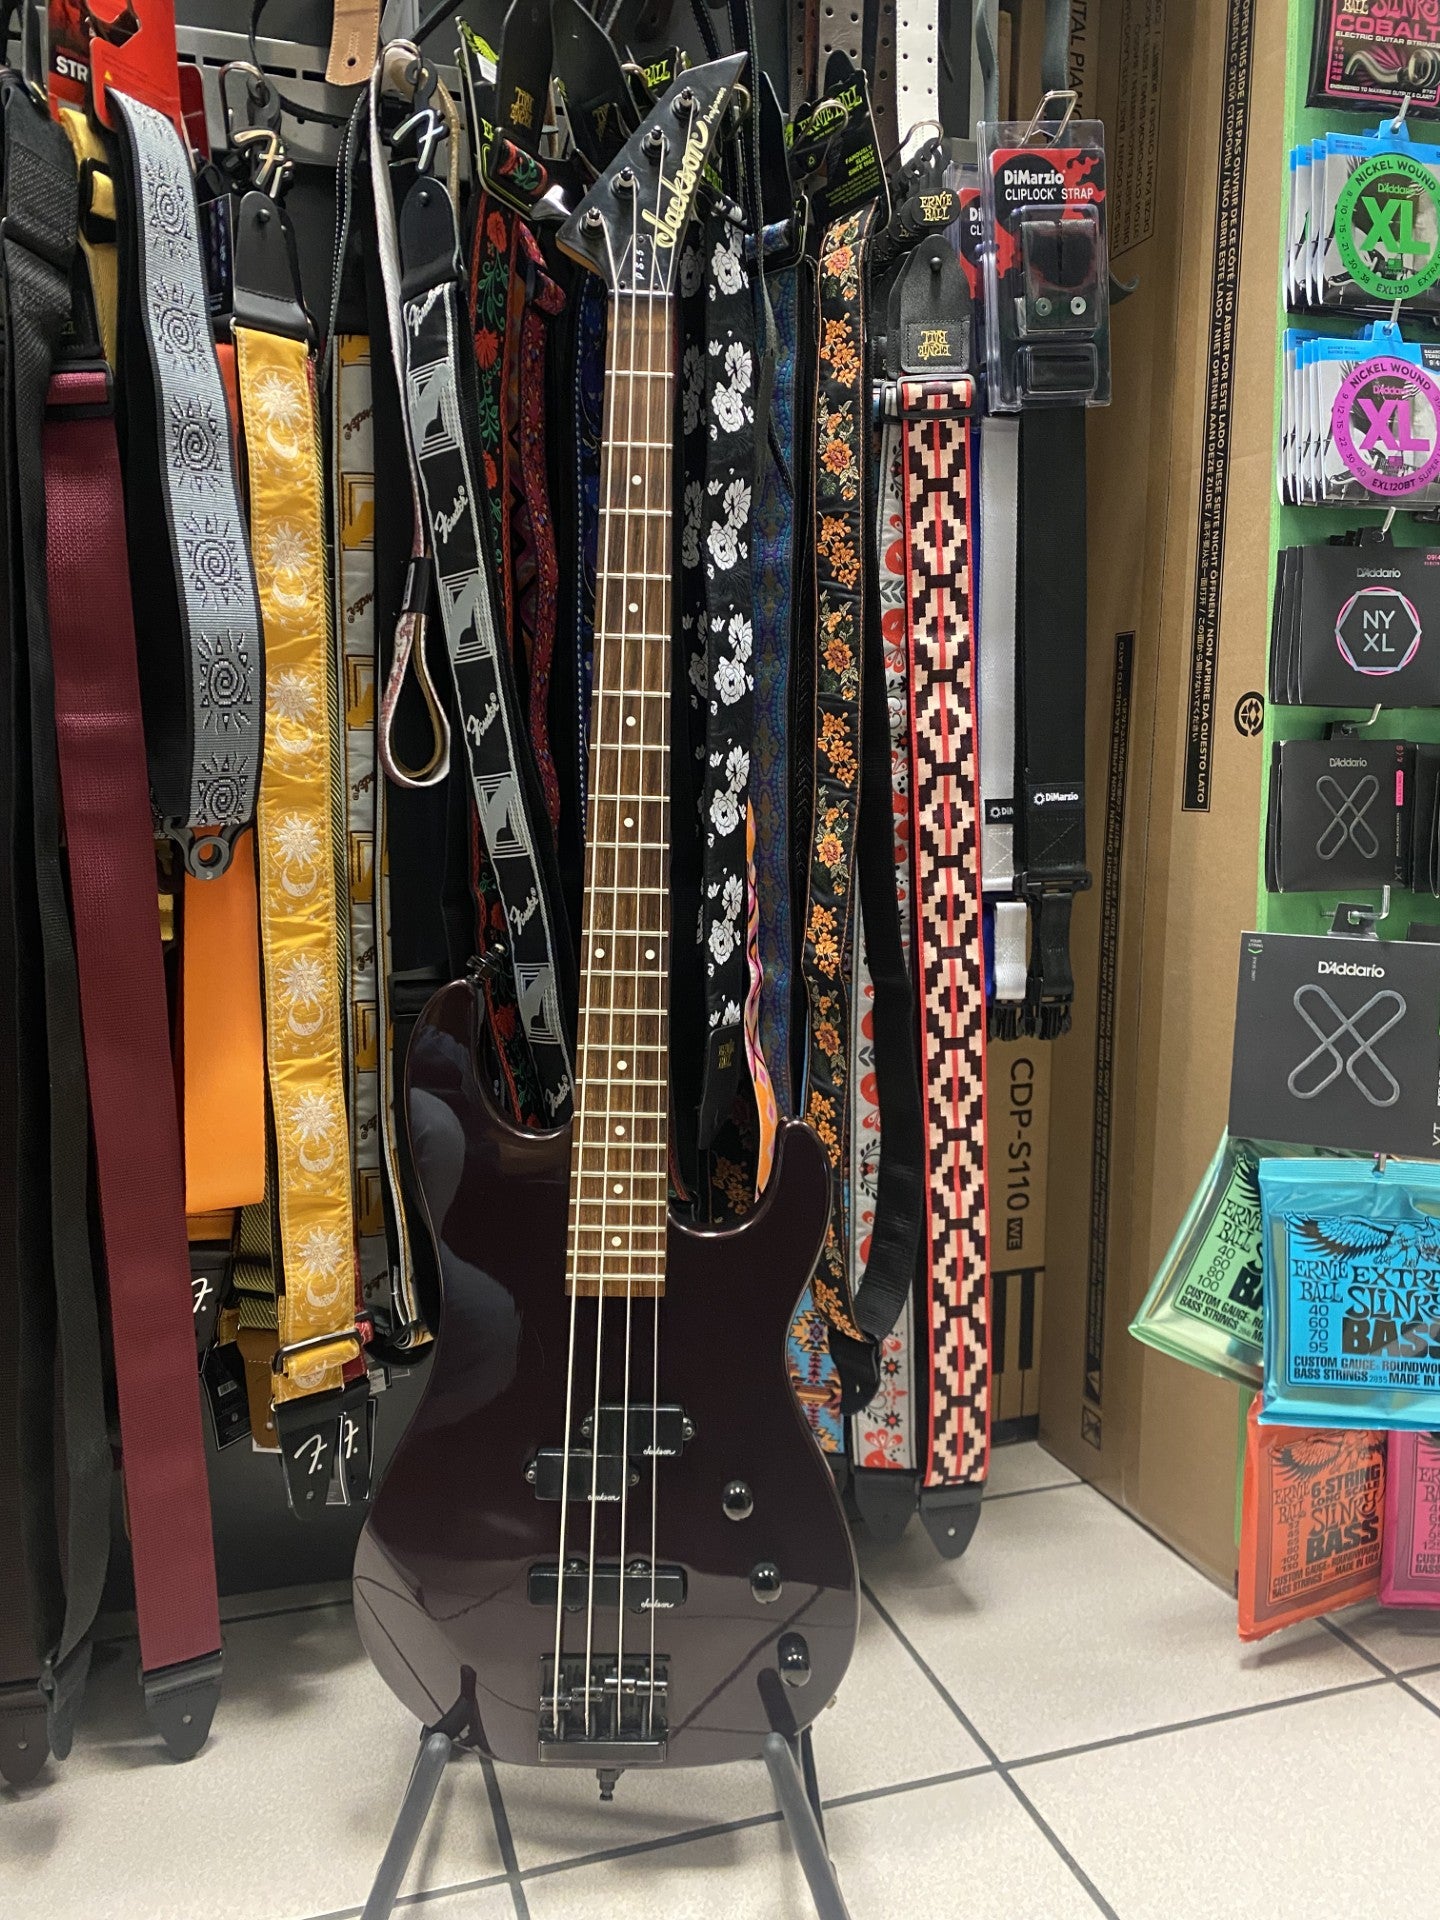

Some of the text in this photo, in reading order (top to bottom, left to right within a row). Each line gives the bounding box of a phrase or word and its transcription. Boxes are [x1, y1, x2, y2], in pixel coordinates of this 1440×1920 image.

[1335, 31, 1374, 41] ELECTRIC
[1375, 36, 1405, 45] GUITAR
[1336, 14, 1440, 42] COBALT
[642, 120, 709, 249] Jackson
[1003, 168, 1066, 187] DiMarzio
[1355, 159, 1437, 192] NICKEL WOUND
[1005, 187, 1094, 200] CLIPLOCK STRAP
[923, 205, 950, 222] BALL
[1359, 196, 1431, 256] XL
[1220, 211, 1229, 249] ABRIR
[1217, 250, 1226, 281] ESTE
[1215, 283, 1224, 318] LADO
[1213, 329, 1221, 356] NIET
[1210, 359, 1219, 410] OPENEN
[1350, 362, 1431, 391] NICKEL WOUND
[1197, 0, 1250, 803] OPEN THIS SIDE NE PAS OUVRIR DE CE CÔTÉ NO ABRIR POR ESTE LADO DIESE SEITE NICHT ÖFFNEN NON APRIRE DA QUESTO LATO
[1209, 413, 1217, 440] AAN
[1356, 398, 1431, 452] XL
[1207, 442, 1215, 473] DEZE
[1205, 476, 1213, 510] ZIJDE
[1363, 609, 1396, 629] NY
[1363, 632, 1396, 652] XL
[1317, 960, 1386, 979] D'Addario
[1007, 1057, 1034, 1212] CDP-S110
[1215, 1220, 1253, 1253] BALL
[1213, 1255, 1231, 1271] 60
[1218, 1245, 1236, 1260] 40
[1206, 1266, 1225, 1281] 80
[1291, 1255, 1349, 1282] ERNIE
[1198, 1274, 1220, 1293] 100
[1298, 1280, 1344, 1304] BALL
[1179, 1294, 1203, 1314] BASS
[1202, 1306, 1240, 1332] STRINGS
[1184, 1284, 1222, 1310] CUSTOM
[1221, 1300, 1251, 1323] GAUGE
[1308, 1304, 1329, 1317] 40
[1308, 1317, 1329, 1329] 60
[1309, 1329, 1329, 1341] 70
[1308, 1341, 1329, 1354] 95
[1294, 1355, 1337, 1368] CUSTOM
[1341, 1357, 1375, 1371] GAUGE
[1294, 1368, 1321, 1380] BASS
[1323, 1369, 1368, 1383] STRINGS
[1388, 1372, 1420, 1386] MADE
[1424, 1374, 1435, 1386] IN
[1311, 1463, 1381, 1499] 6-STRING
[1306, 1515, 1379, 1566] BASS
